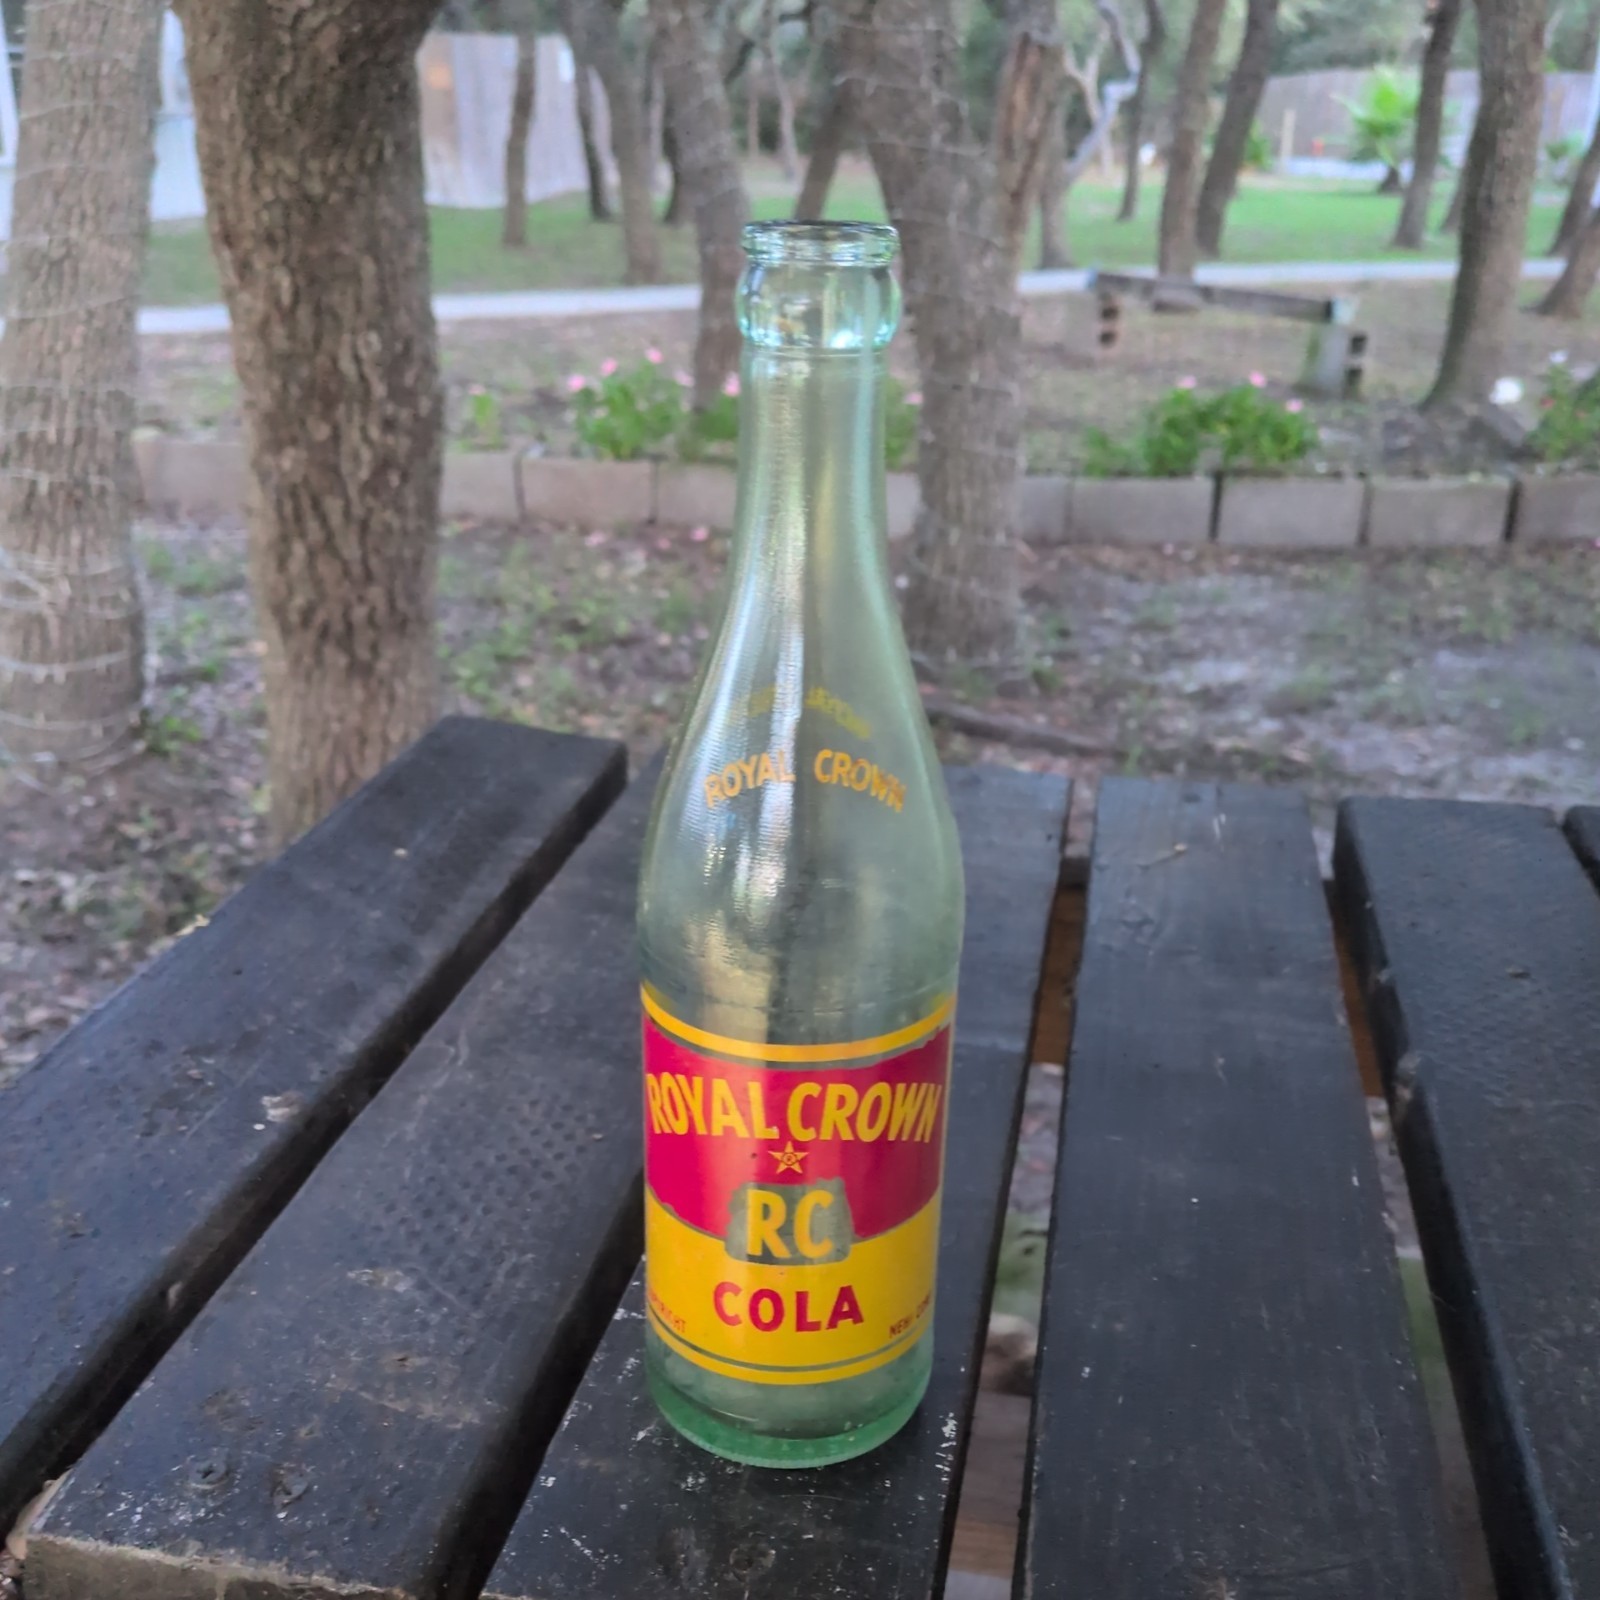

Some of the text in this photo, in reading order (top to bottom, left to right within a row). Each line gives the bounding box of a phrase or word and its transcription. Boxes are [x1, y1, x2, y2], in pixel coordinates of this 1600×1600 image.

[704, 749, 906, 812] ROYAL CROWN
[646, 1072, 942, 1142] ROYAL CROWN
[747, 1188, 834, 1258] RC
[713, 1281, 864, 1332] COLA
